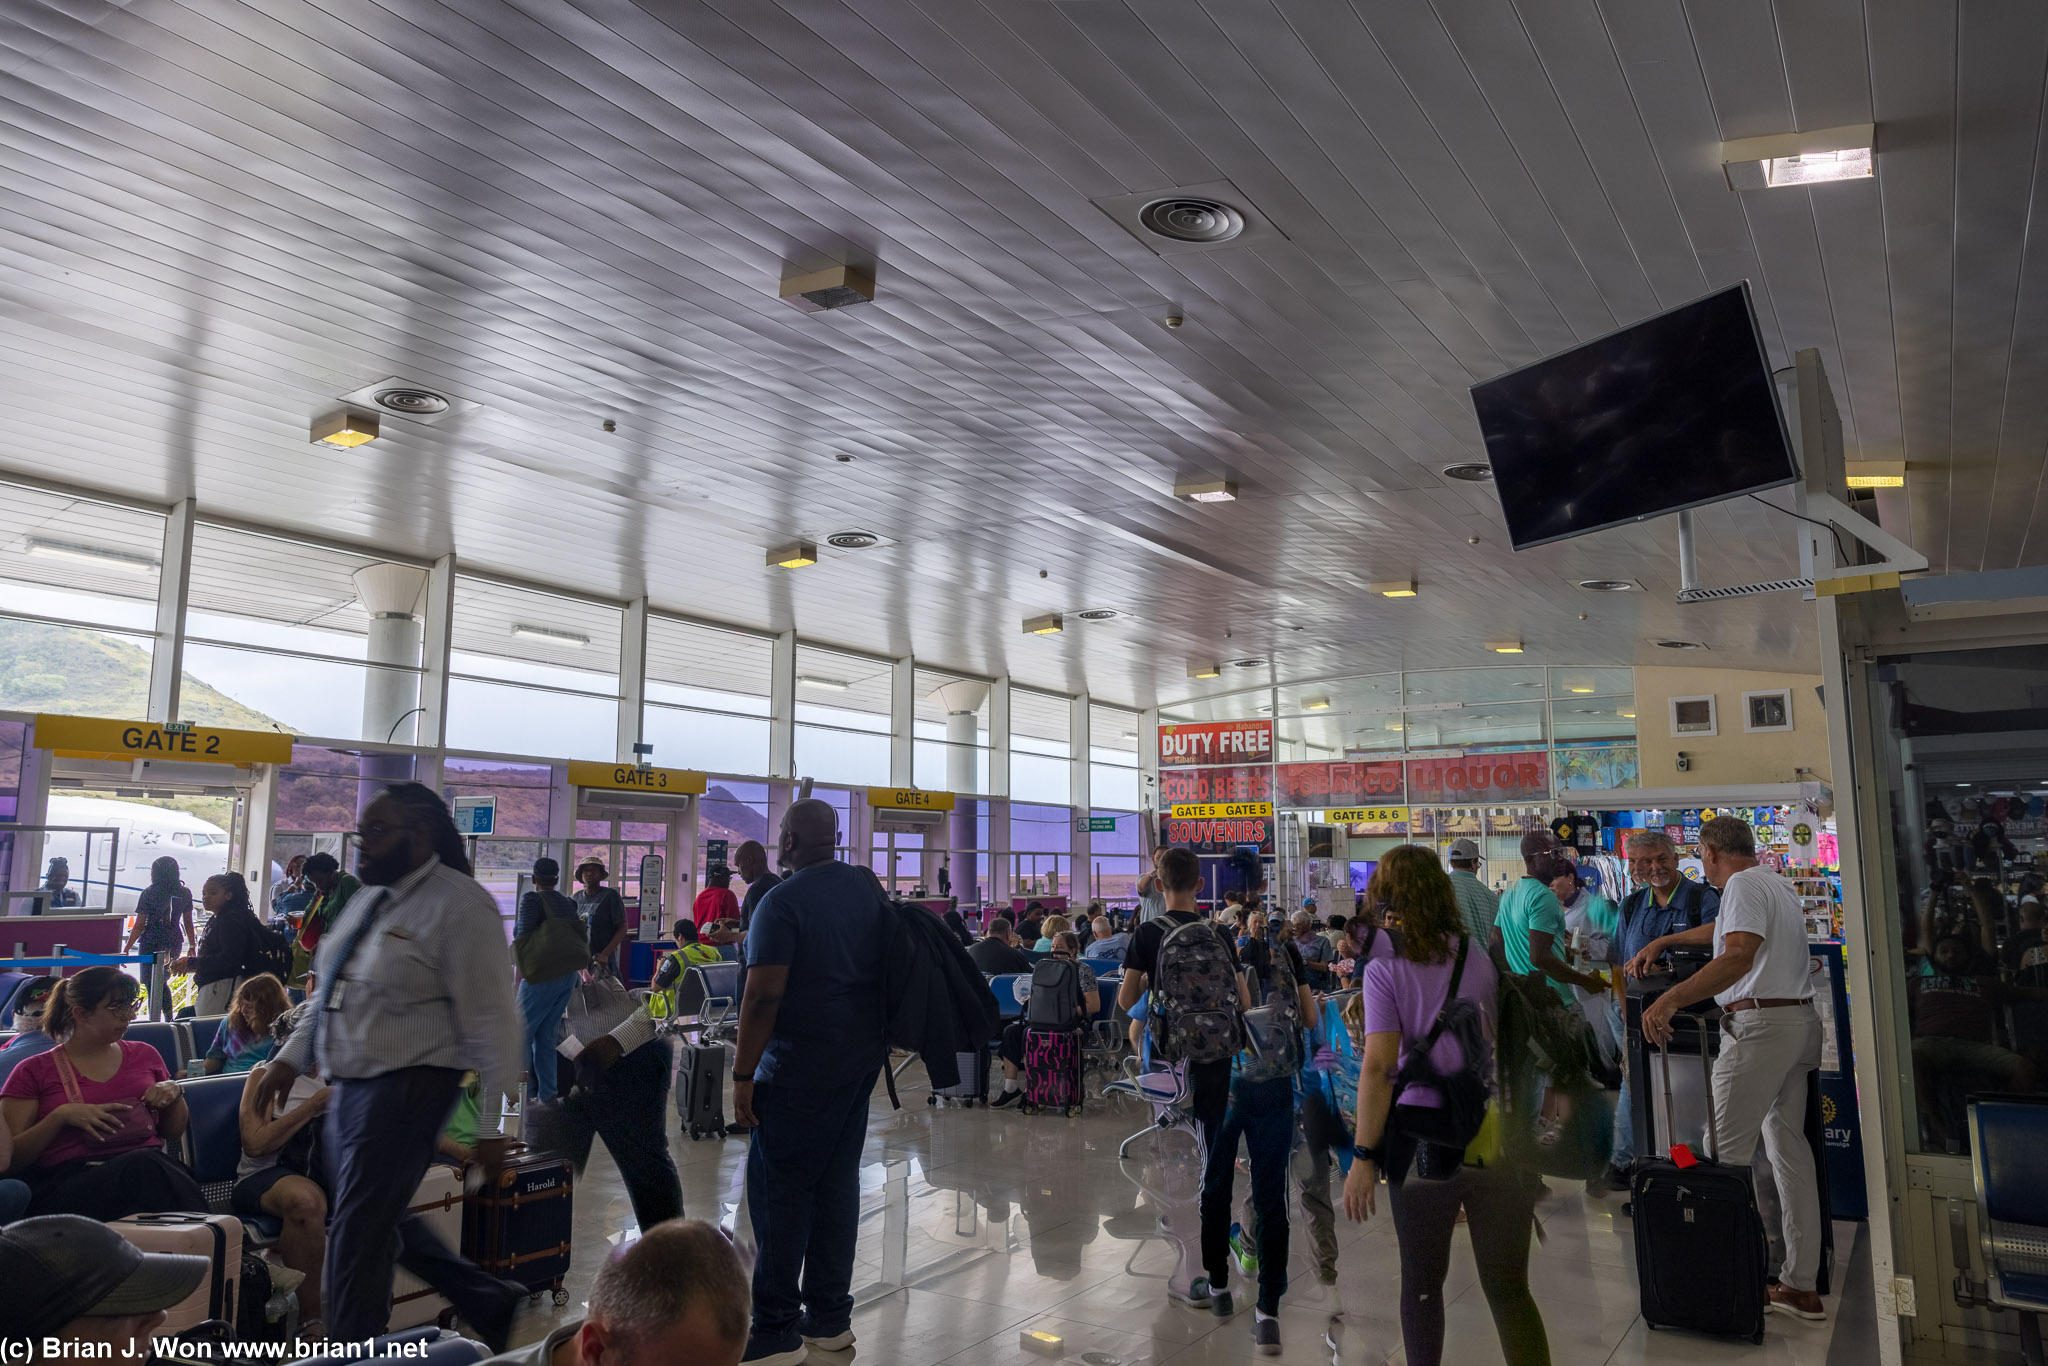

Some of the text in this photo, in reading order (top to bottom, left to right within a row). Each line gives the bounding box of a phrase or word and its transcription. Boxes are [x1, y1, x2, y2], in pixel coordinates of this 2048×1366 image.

[167, 723, 191, 732] EXIT
[122, 727, 220, 754] GATE 2
[1162, 729, 1270, 756] DUTY FREE
[614, 768, 667, 787] GATE 3
[1288, 772, 1397, 795] TOBACCO
[1416, 763, 1542, 791] LIQUOR
[1166, 776, 1270, 801] COLD BEERS
[896, 792, 929, 805] GATE 4
[1177, 805, 1266, 816] GATE 5 GATE 5
[1333, 810, 1399, 821] GATE 5 & 6
[474, 817, 487, 827] 5-9
[1169, 820, 1265, 843] SOUVENIRS
[1825, 1128, 1851, 1142] ary
[527, 1178, 555, 1192] Harold
